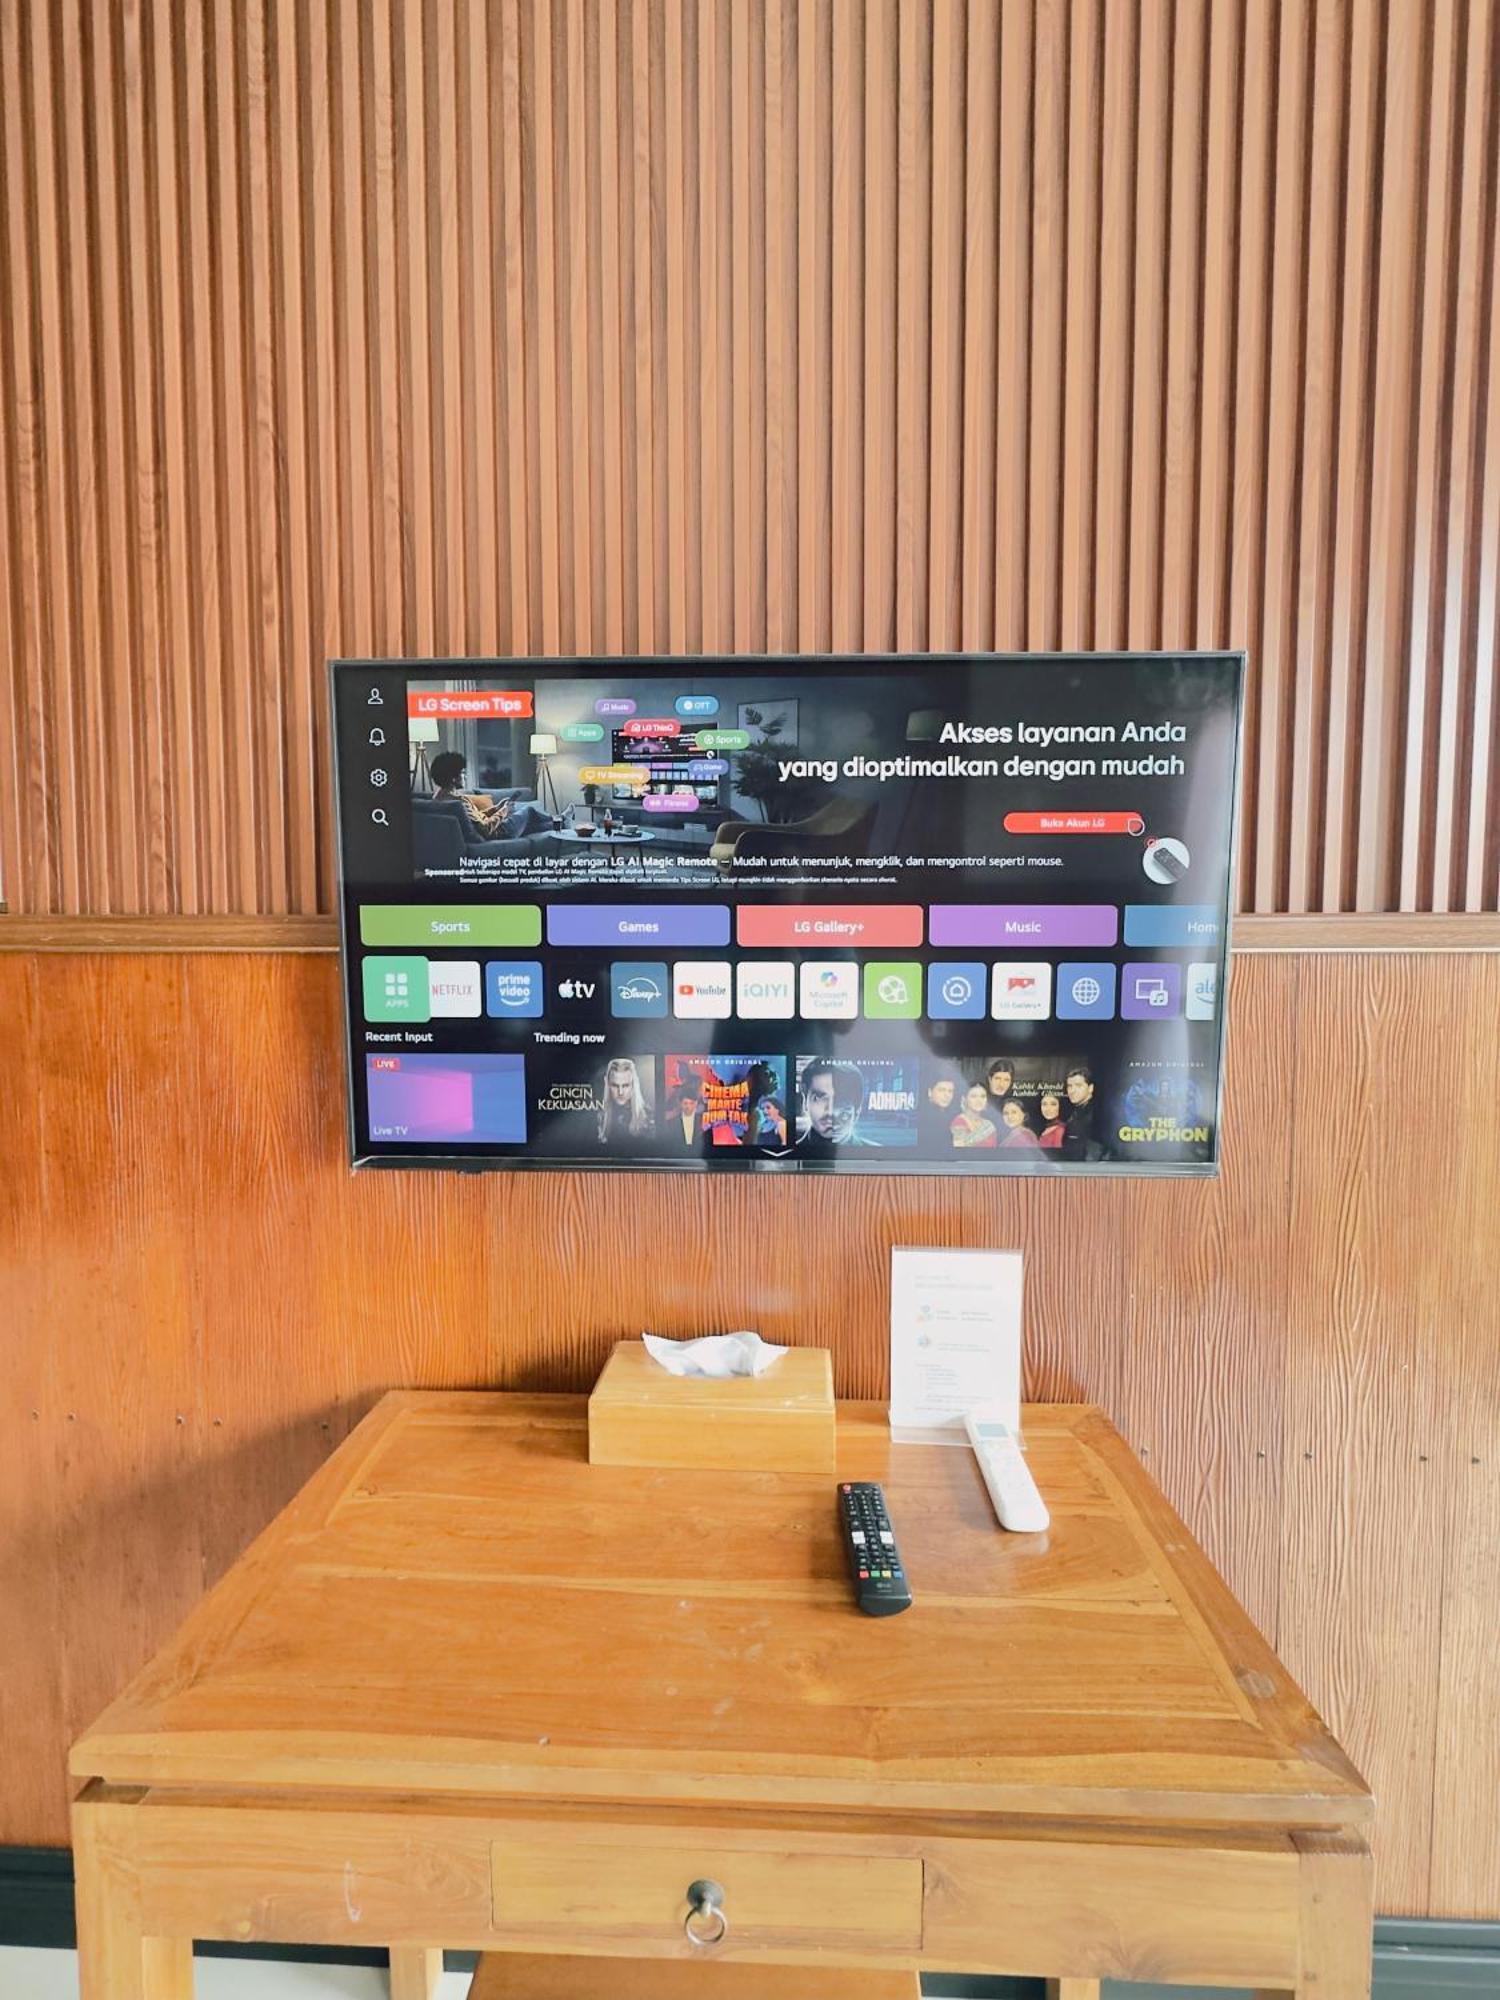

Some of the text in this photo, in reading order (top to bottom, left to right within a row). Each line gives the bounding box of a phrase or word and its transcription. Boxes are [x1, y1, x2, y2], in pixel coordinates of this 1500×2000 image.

[418, 698, 522, 714] LG Screen Tips
[939, 721, 1187, 748] Akses layanan Anda
[778, 754, 1185, 782] yang dioptimalkan dengan mudah
[1066, 817, 1090, 828] Akun
[460, 856, 501, 869] Navigasi
[503, 857, 530, 870] cepat
[533, 856, 542, 867] di
[544, 857, 569, 869] layar
[571, 857, 608, 869] dengan
[611, 857, 625, 867] LG
[627, 857, 640, 867] AI
[642, 856, 674, 869] Magic
[676, 857, 718, 867] Remote
[733, 856, 767, 867] Mudah
[770, 857, 799, 867] untuk
[801, 856, 853, 869] menunjuk,
[855, 856, 903, 869] mengklik,
[905, 855, 925, 866] dan
[927, 855, 987, 869] mengontrol
[988, 856, 1025, 869] seperti
[1027, 857, 1064, 866] mouse.
[430, 920, 471, 935] Sports
[618, 920, 659, 933] Games
[794, 920, 865, 935] LG Gallery+
[1005, 920, 1042, 933] Music
[1187, 920, 1218, 933] Hom
[498, 974, 530, 987] prime
[431, 984, 473, 996] NETFLIX
[498, 986, 530, 997] video
[574, 981, 596, 998] tv
[696, 985, 726, 996] YouTube
[809, 990, 848, 999] Microsoft
[365, 1031, 434, 1044] Recent Input
[533, 1032, 606, 1045] Trending now
[376, 1060, 395, 1069] LIVE
[550, 1087, 593, 1099] CINCIN
[538, 1098, 606, 1111] KEKUASAAN
[867, 1091, 916, 1111] ADHURA
[1149, 1117, 1178, 1129] THE
[373, 1126, 408, 1136] Live TV
[1118, 1126, 1209, 1143] GRYPHON
